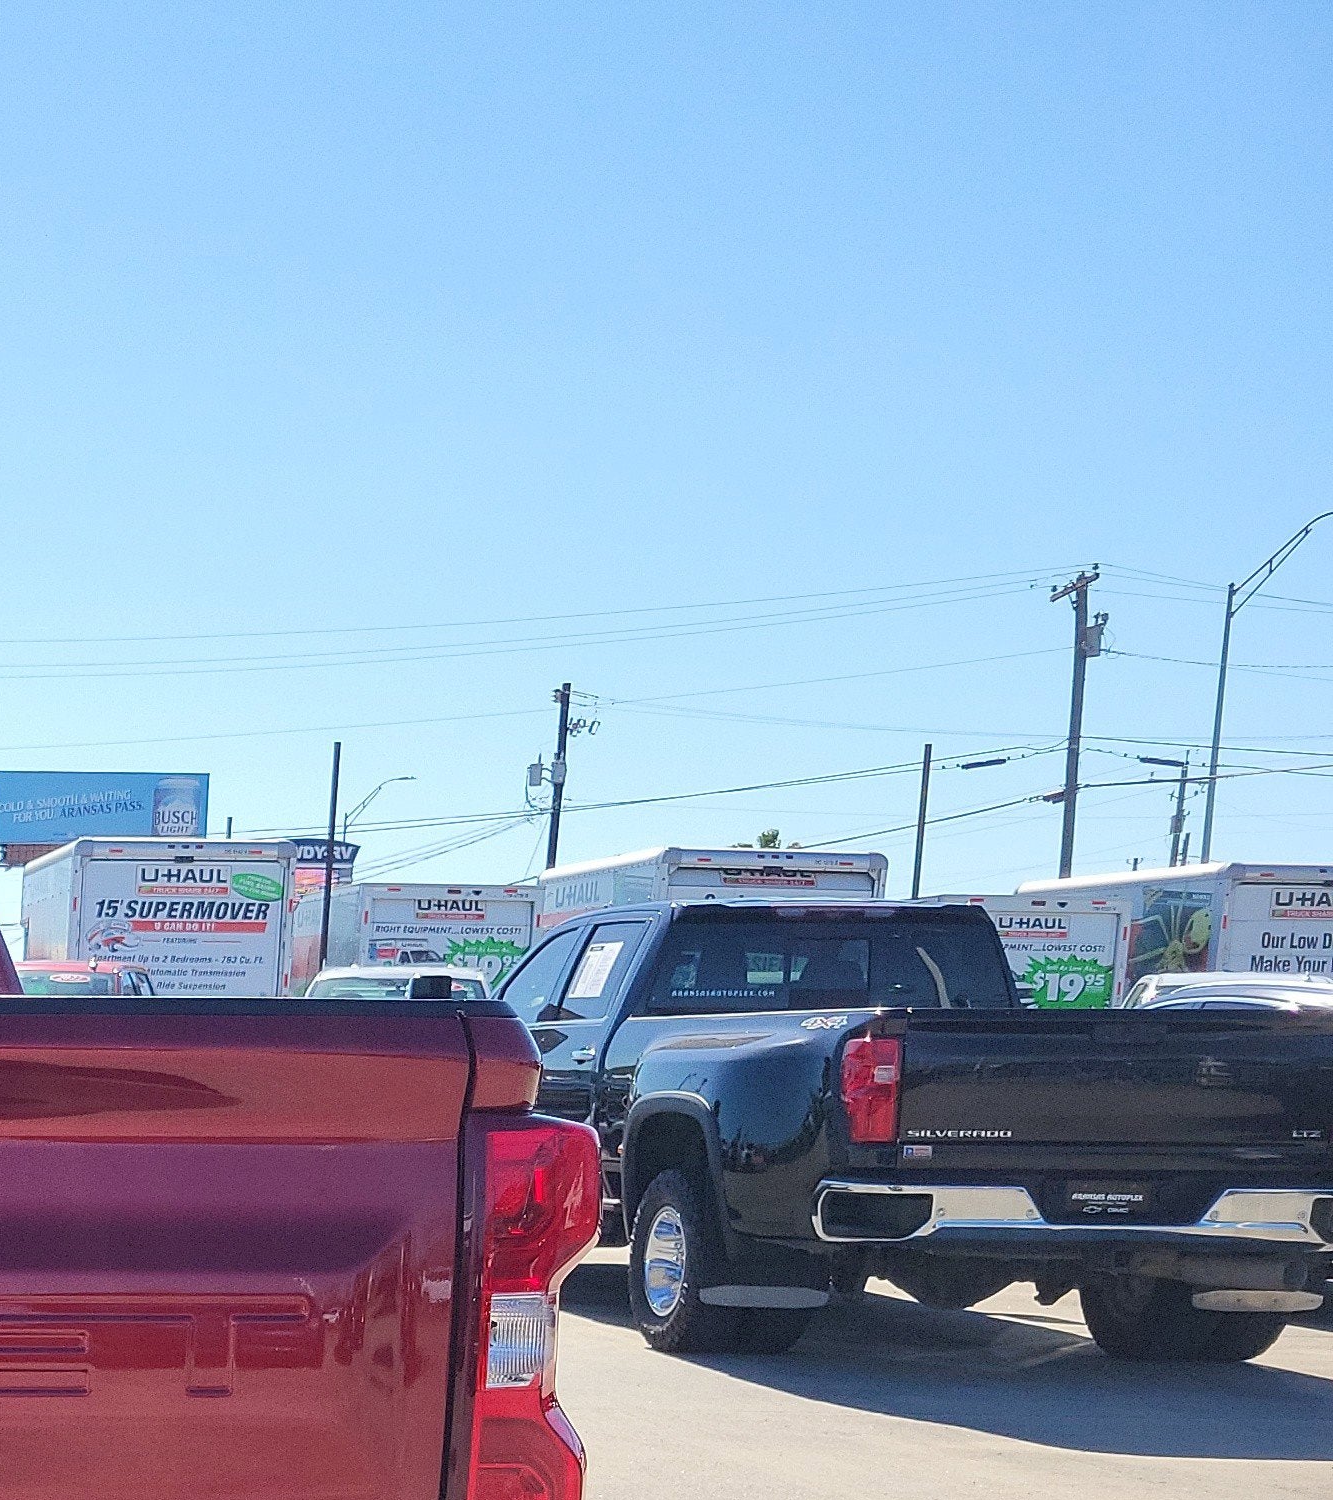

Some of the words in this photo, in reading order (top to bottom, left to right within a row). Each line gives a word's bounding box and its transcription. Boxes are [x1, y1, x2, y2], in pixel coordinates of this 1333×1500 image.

[89, 790, 132, 802] WAITING
[13, 811, 33, 824] FOR
[59, 802, 113, 818] ARANSAS
[154, 810, 198, 826] BUSCH
[160, 826, 191, 834] LIGHT
[140, 868, 228, 884] U-HAUL
[124, 900, 270, 920] SUPERMOVER
[417, 899, 484, 911] U-HAUL
[998, 917, 1067, 929] U-HAUL
[1261, 932, 1286, 949] Our
[1289, 932, 1319, 949] Low
[138, 954, 149, 963] Up
[170, 955, 212, 963] Bedrooms
[1250, 955, 1291, 972] Make
[1296, 956, 1328, 973] Your
[147, 968, 187, 977] utomatic
[191, 968, 246, 977] Transmission
[907, 1130, 1013, 1139] SILVERADO
